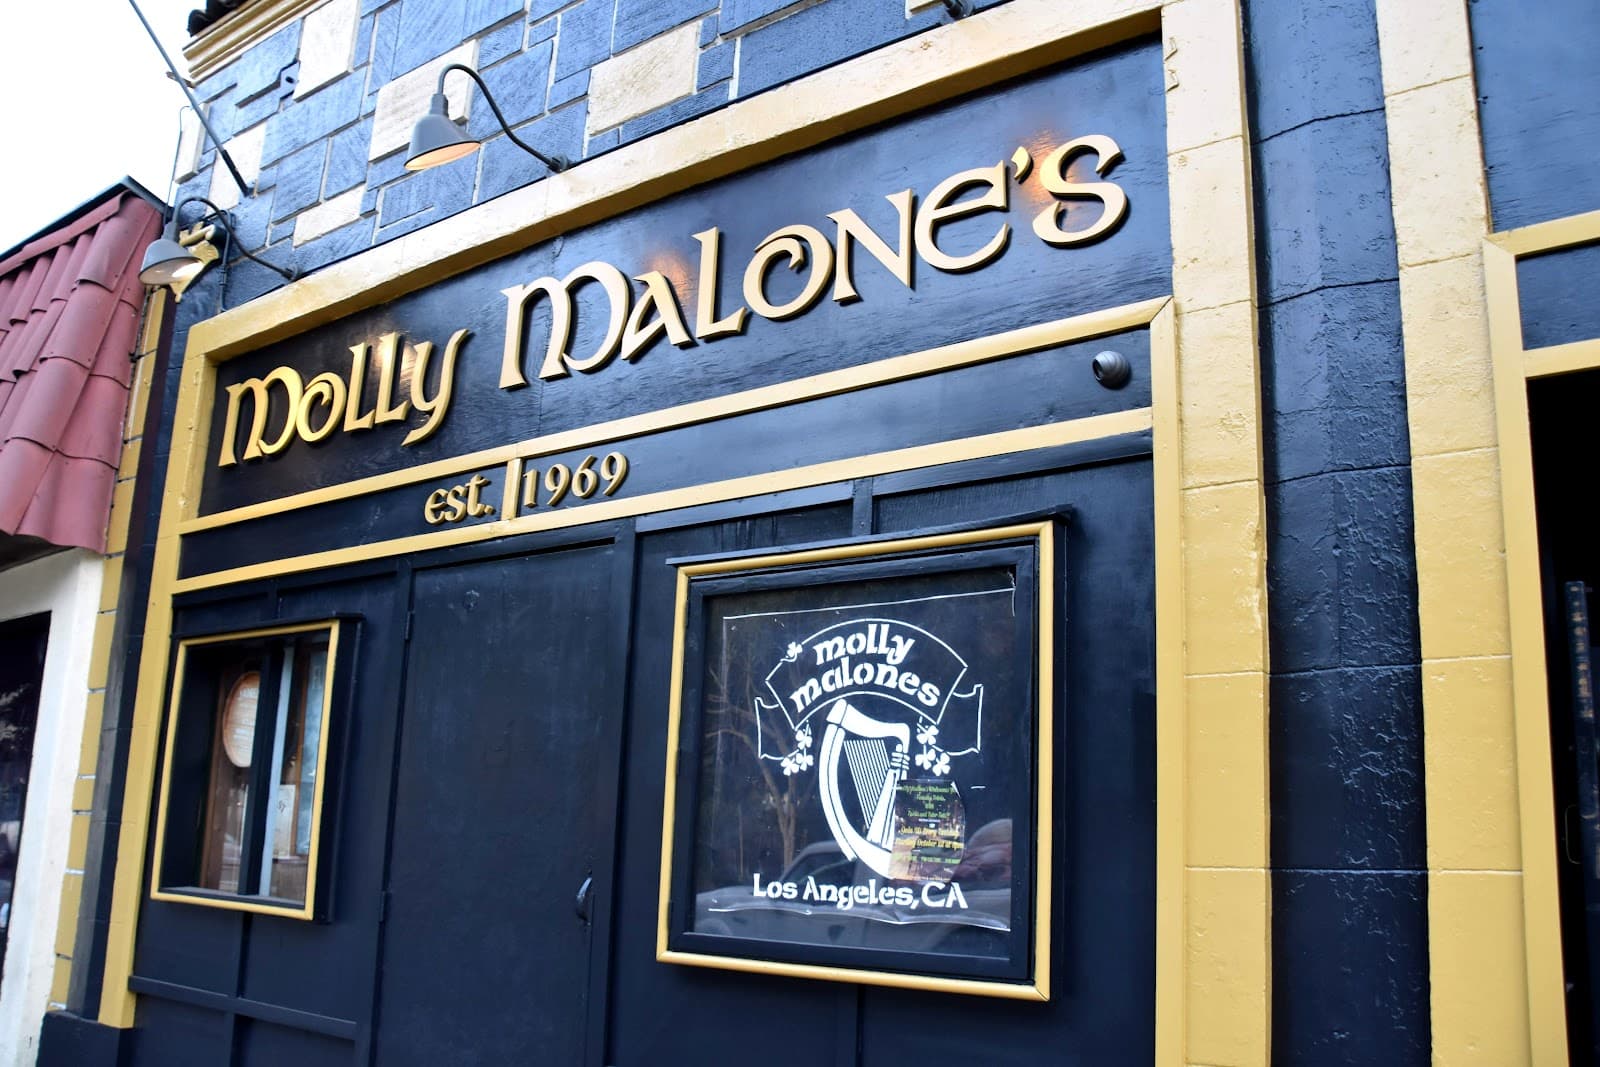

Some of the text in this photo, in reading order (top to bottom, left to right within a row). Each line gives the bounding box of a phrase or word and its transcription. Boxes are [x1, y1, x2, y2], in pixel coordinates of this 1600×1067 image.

[423, 451, 629, 525] est. 1969
[812, 623, 916, 666] molly
[789, 656, 941, 713] malones
[752, 872, 799, 900] Los
